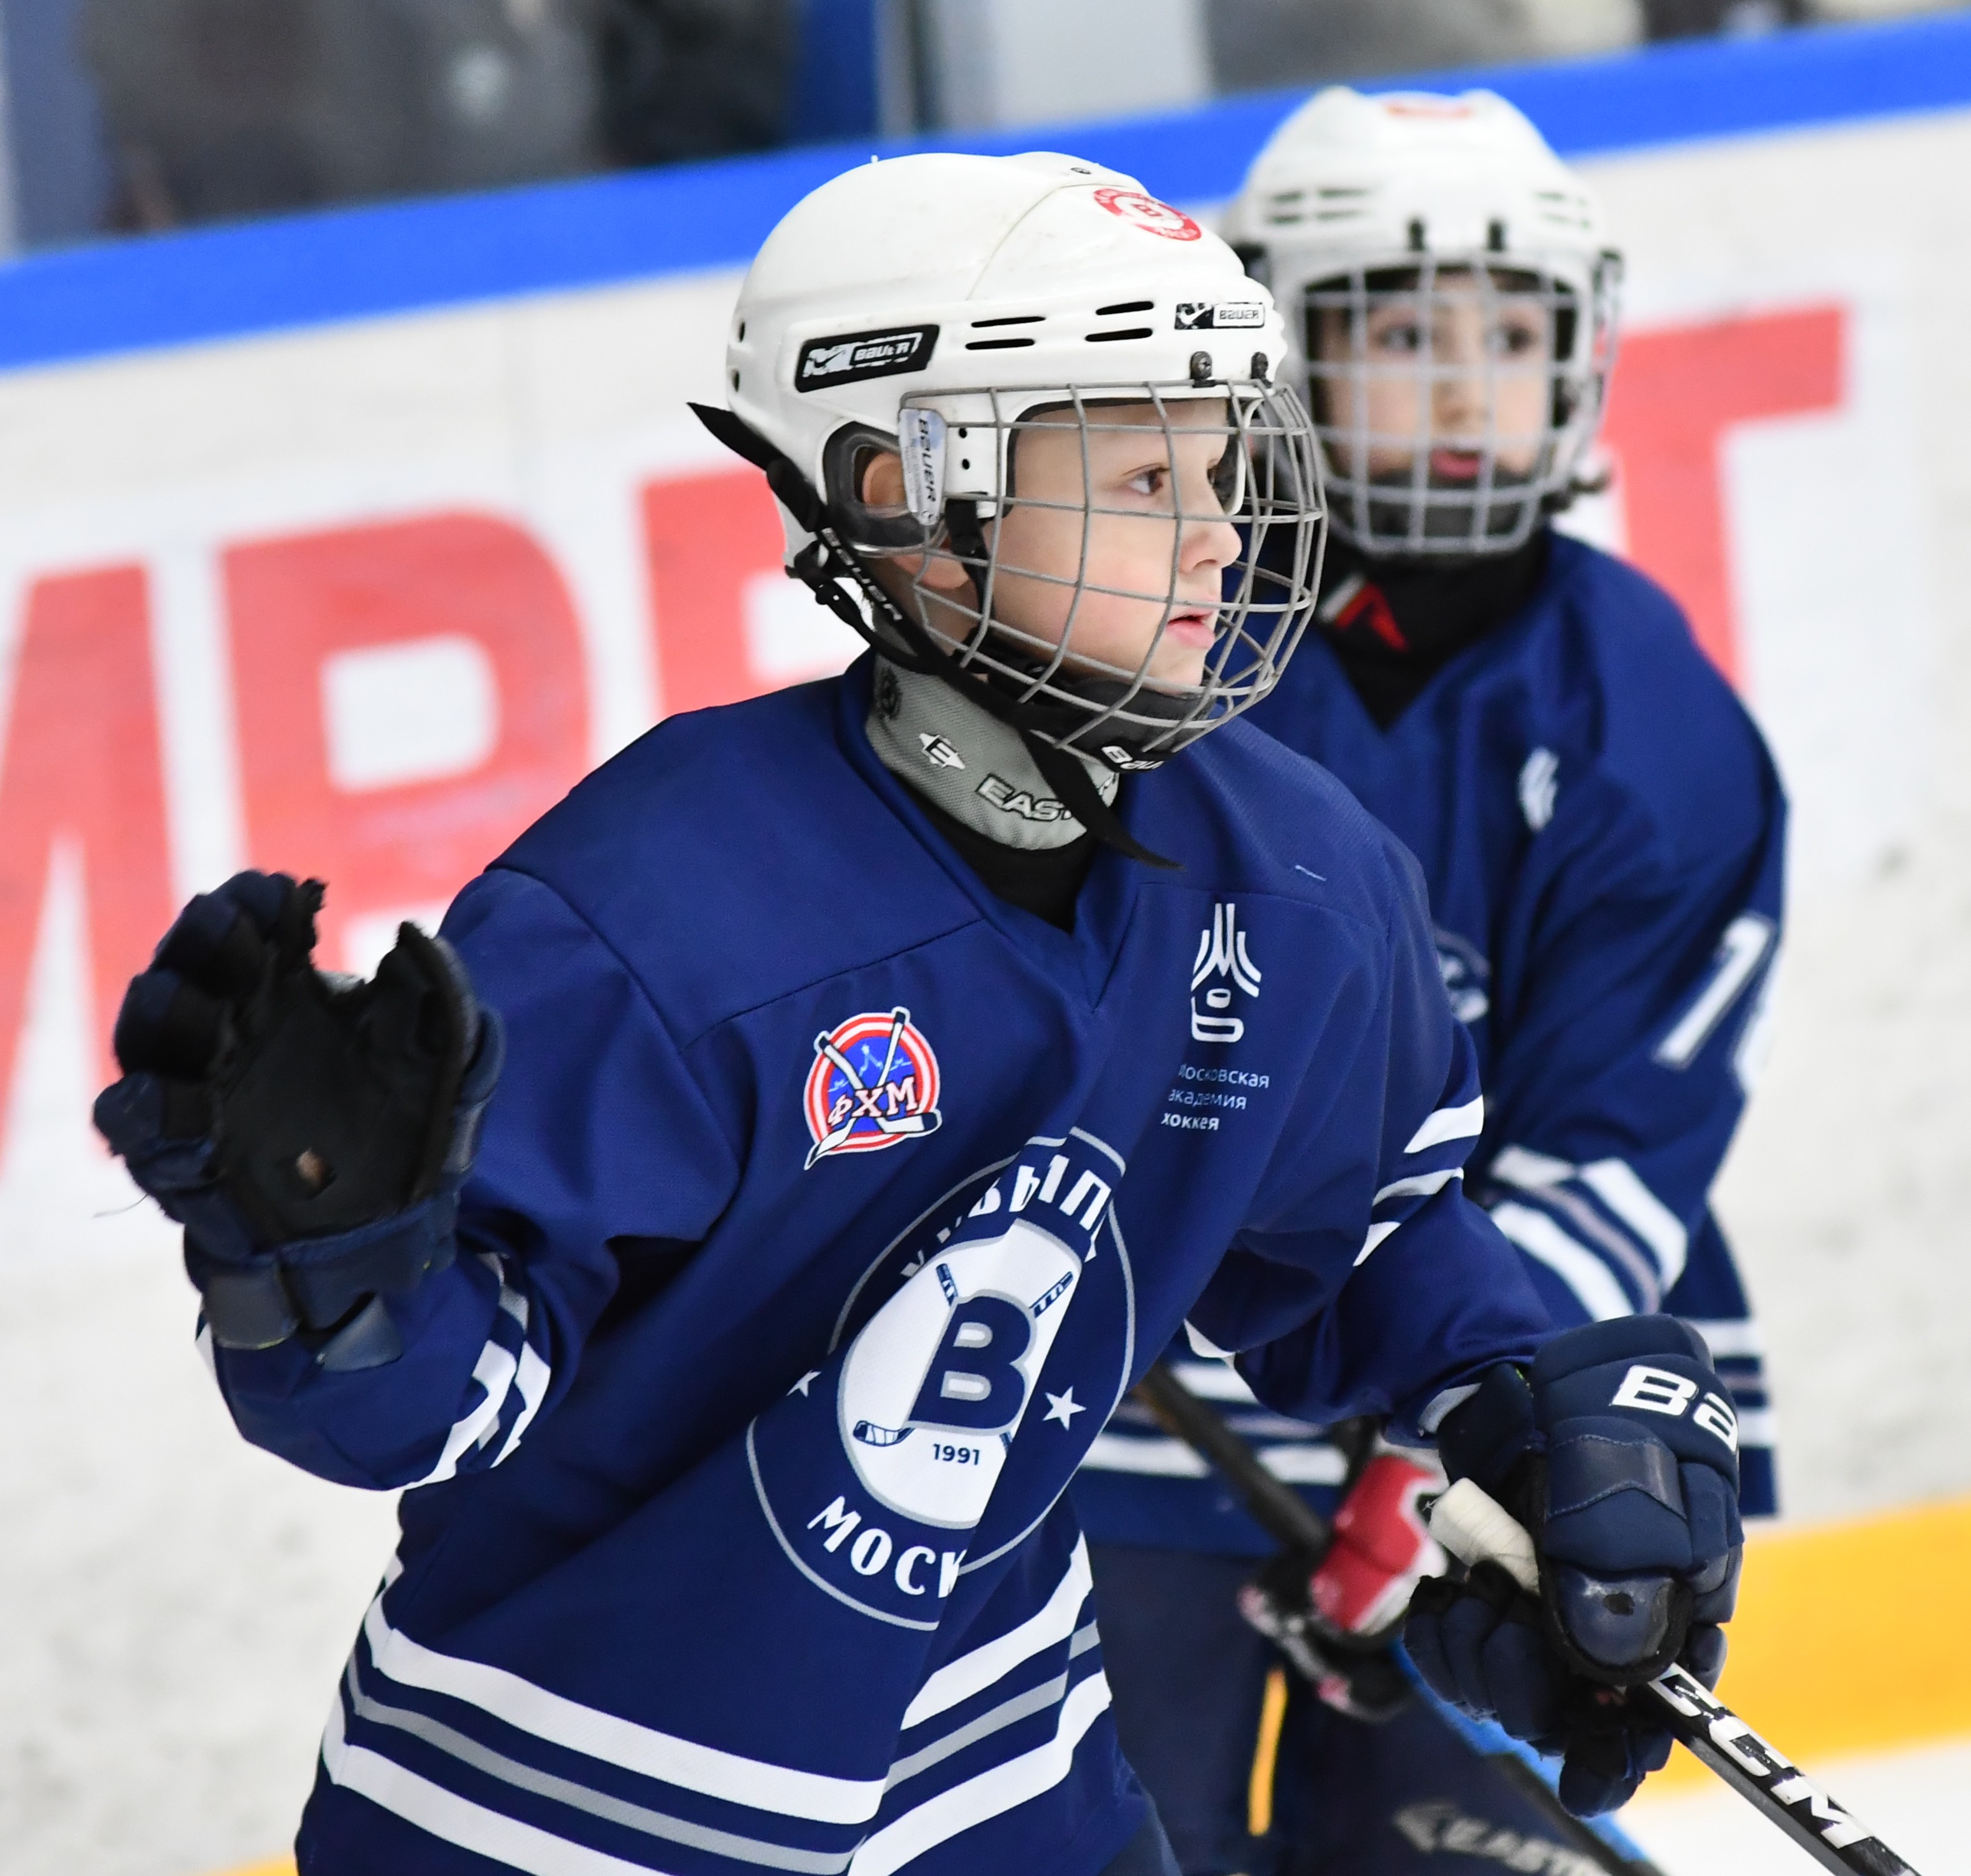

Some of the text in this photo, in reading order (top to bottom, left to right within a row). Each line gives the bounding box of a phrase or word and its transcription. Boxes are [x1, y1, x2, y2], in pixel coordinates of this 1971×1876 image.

[1160, 1112, 1220, 1131] хоккея
[933, 1442, 980, 1466] 1991
[1648, 1662, 1875, 1849] CCM
